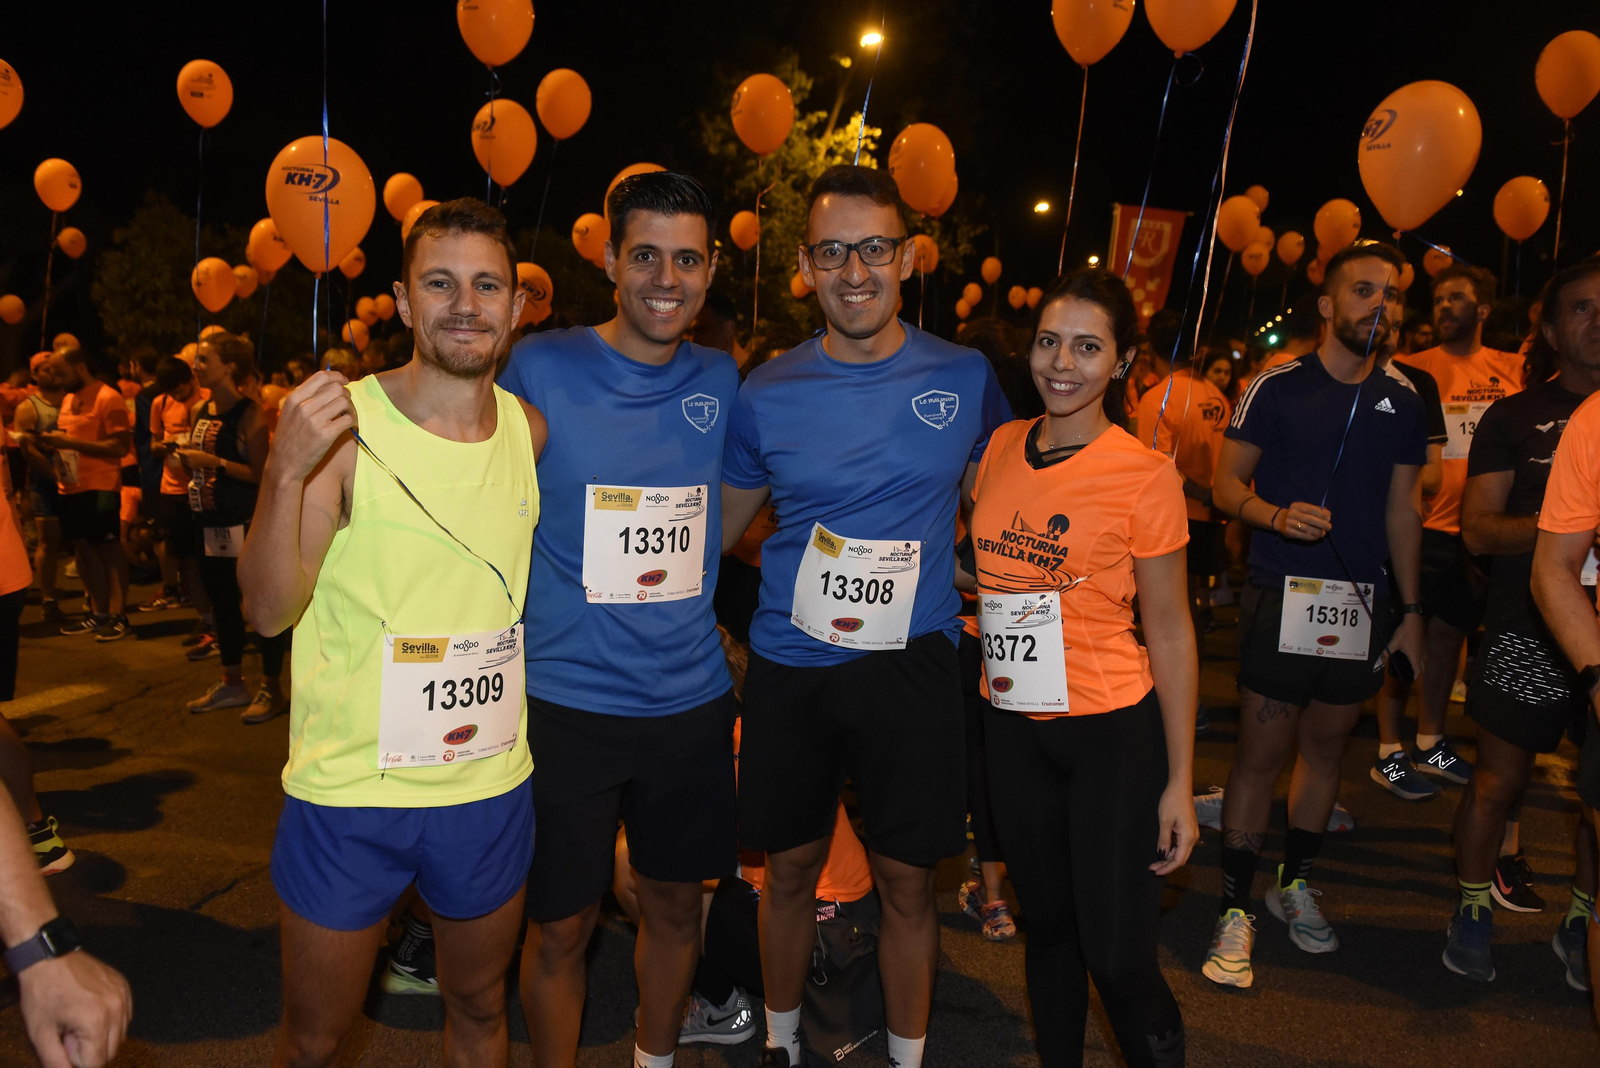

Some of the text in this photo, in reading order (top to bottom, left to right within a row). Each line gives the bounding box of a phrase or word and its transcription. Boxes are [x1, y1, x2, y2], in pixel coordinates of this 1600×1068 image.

[619, 525, 690, 555] 13310
[977, 537, 1026, 563] SEVILLA
[1000, 529, 1069, 558] NOCTURNA
[820, 570, 894, 605] 13308
[1306, 604, 1359, 627] 15318
[401, 642, 439, 653] Sevilla.
[486, 646, 506, 654] SEVILLA
[422, 672, 504, 712] 13309
